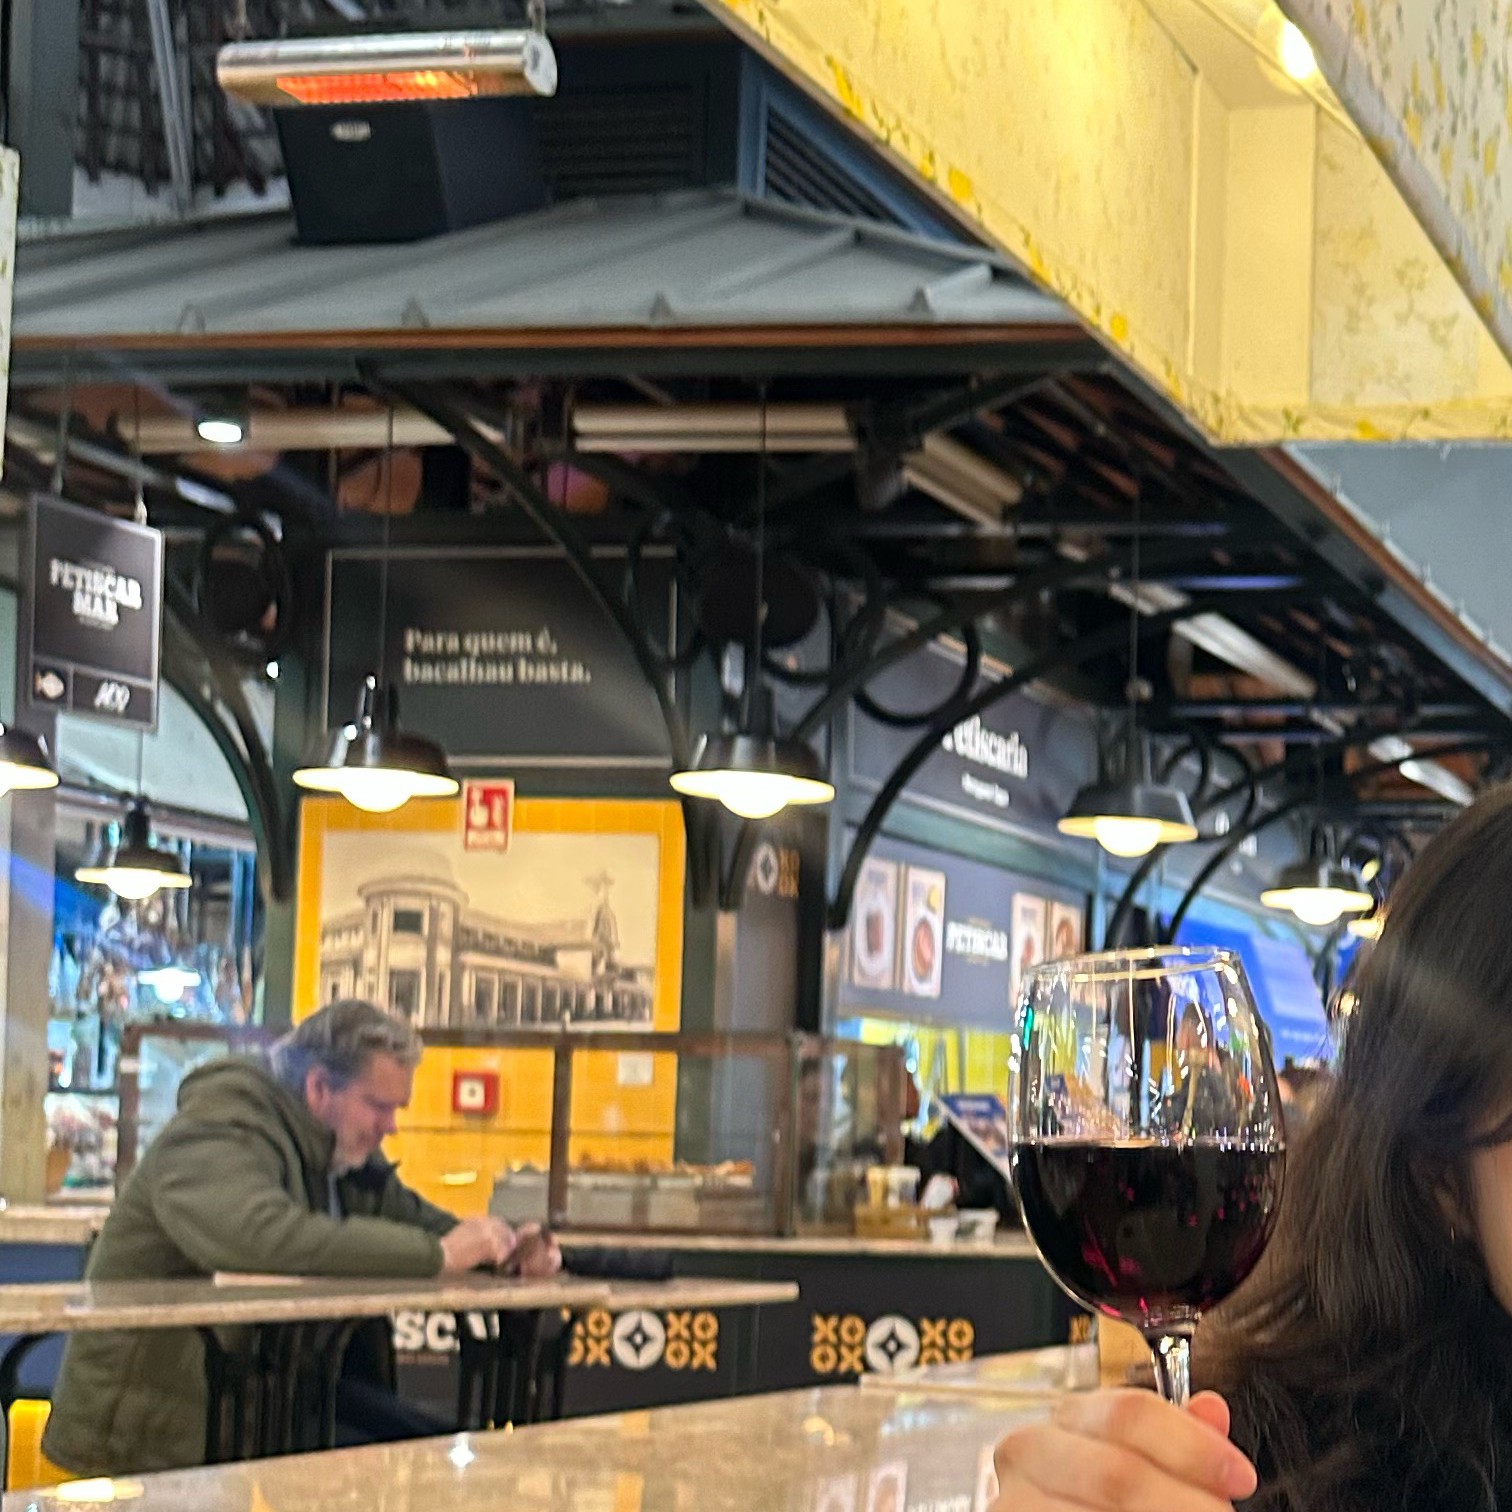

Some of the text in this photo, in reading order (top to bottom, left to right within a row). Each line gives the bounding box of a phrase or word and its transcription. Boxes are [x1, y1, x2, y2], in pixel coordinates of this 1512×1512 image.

[404, 627, 460, 653] Para
[464, 630, 532, 657] quem
[404, 657, 592, 684] bacalhau basta.
[942, 714, 1028, 779] etiscaria
